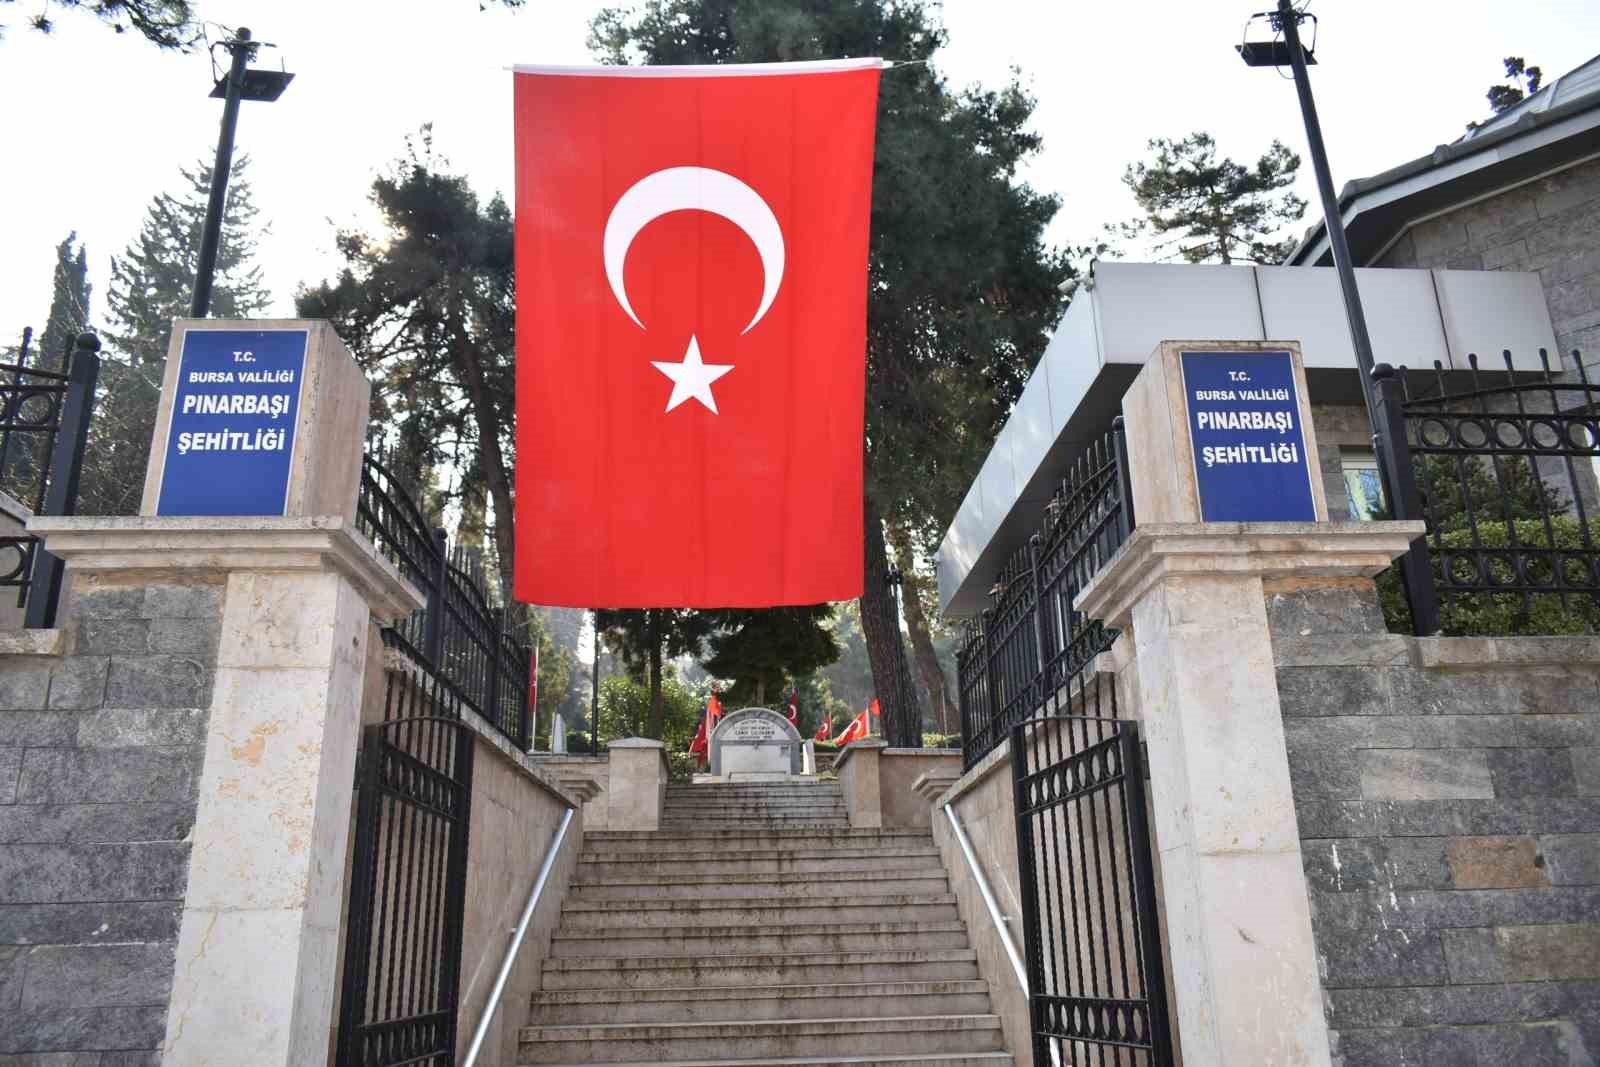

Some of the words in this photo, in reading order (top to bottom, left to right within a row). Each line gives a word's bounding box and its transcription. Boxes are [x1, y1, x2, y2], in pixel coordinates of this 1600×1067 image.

[233, 351, 256, 362] T.C.
[189, 371, 234, 383] BURSA
[238, 369, 294, 383] VALİLİĞİ
[1229, 371, 1250, 381] T.C.
[1196, 390, 1236, 401] BURSA
[1239, 388, 1289, 401] VALİLİĞİ
[183, 395, 290, 418] PINARBAŞI
[1198, 411, 1293, 433] PINARBAŞI
[178, 428, 285, 454] ŞEHİTLİĞİ
[1203, 442, 1298, 467] ŞEHİTLİĞİ
